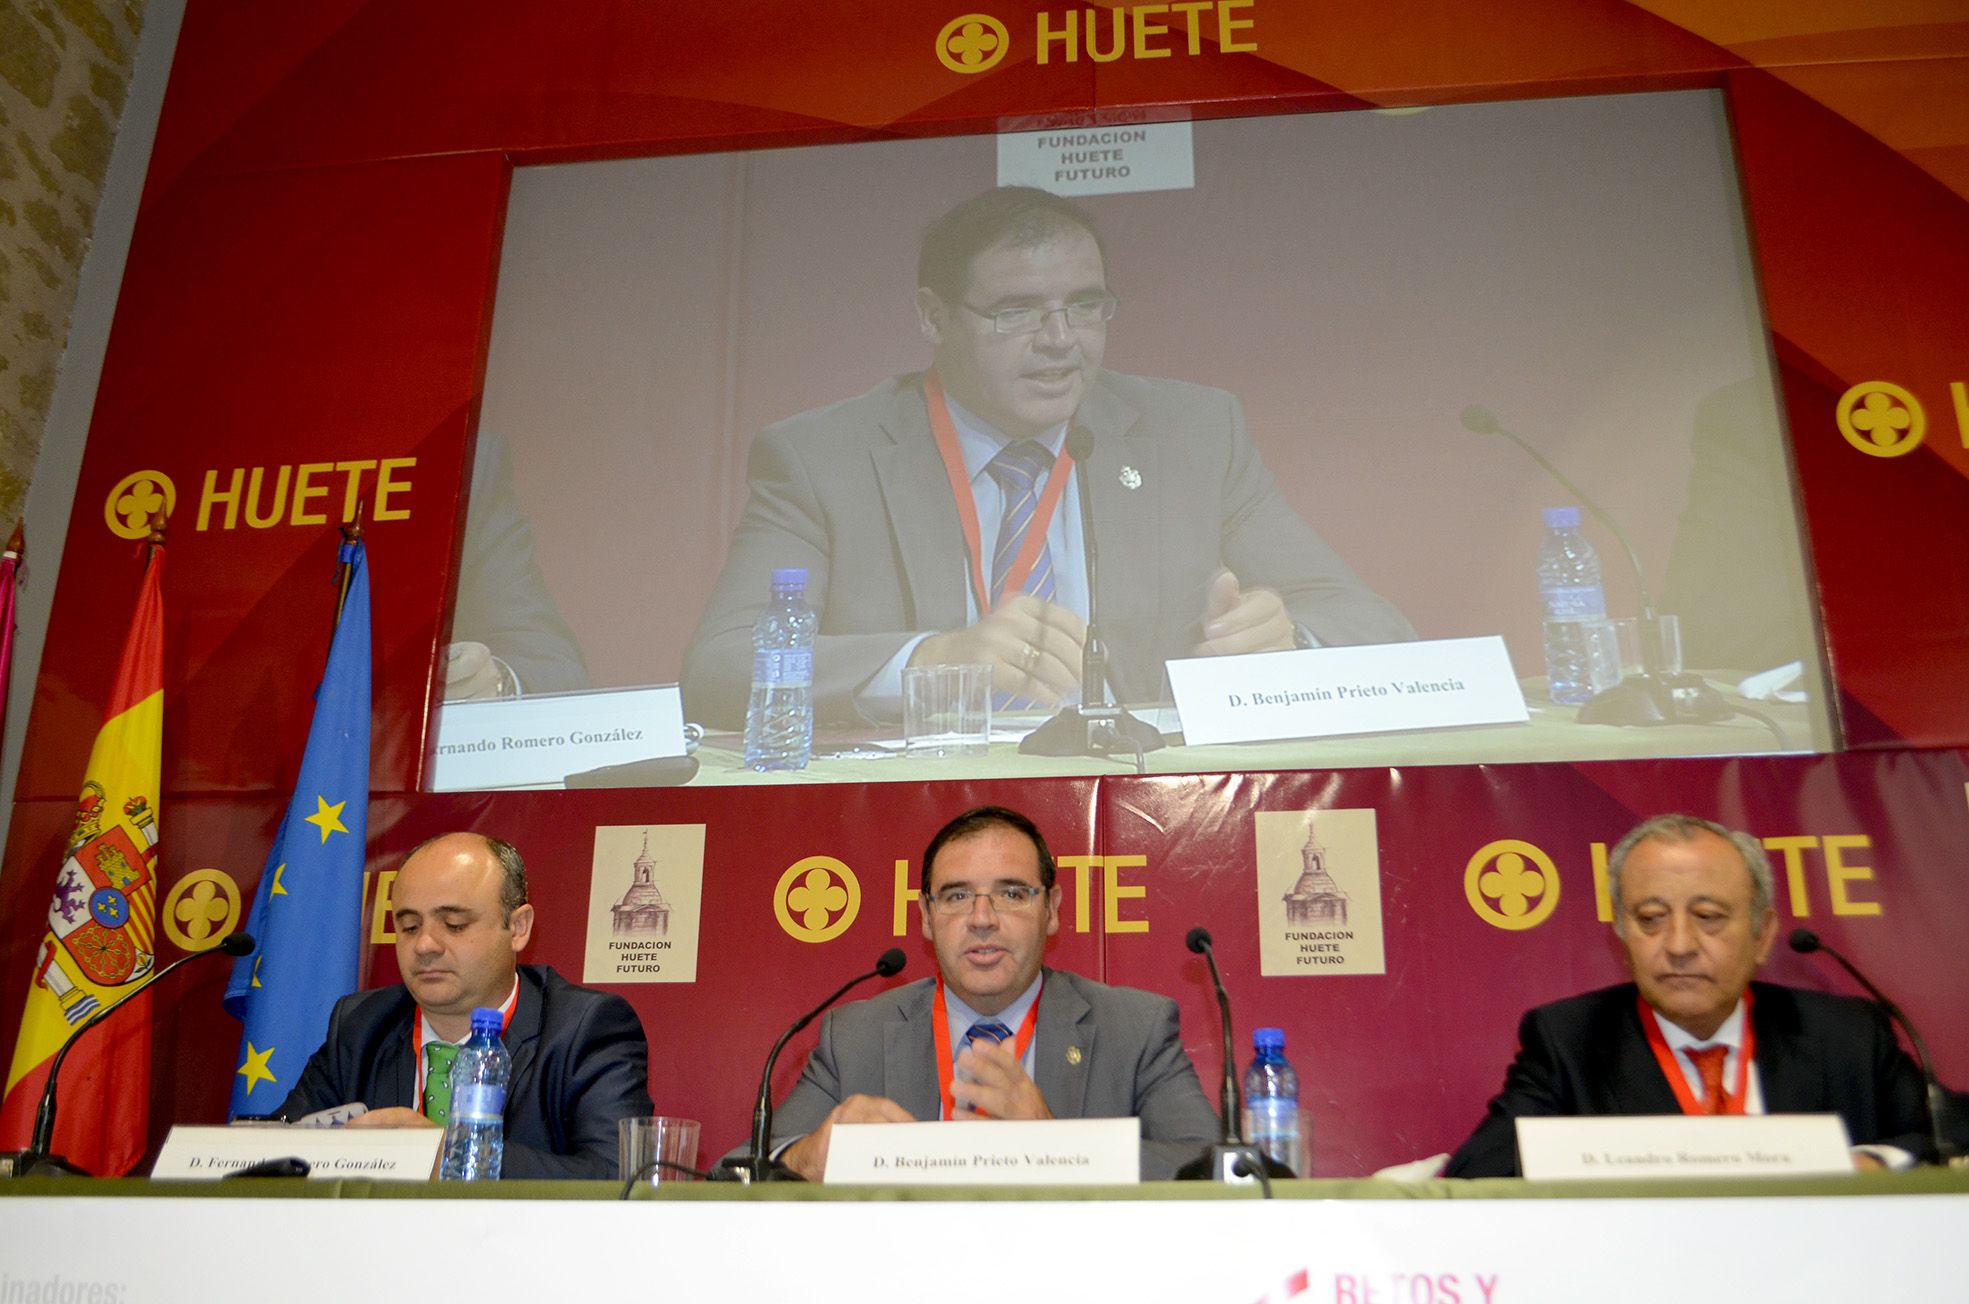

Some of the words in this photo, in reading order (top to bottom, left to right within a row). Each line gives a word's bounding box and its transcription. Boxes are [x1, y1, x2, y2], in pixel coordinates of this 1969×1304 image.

[1036, 1, 1258, 65] HUETE
[1037, 130, 1147, 149] FUNDACION
[1061, 149, 1124, 165] HUETE
[1055, 166, 1131, 182] FUTURO
[196, 457, 417, 532] HUETE
[1228, 694, 1248, 708] D.
[1337, 684, 1388, 699] Prieto
[1393, 678, 1465, 695] Valencia
[502, 736, 566, 750] Romero
[570, 727, 645, 744] González
[1285, 931, 1354, 940] FUNDACION
[609, 941, 672, 950] FUNDACION
[1300, 943, 1340, 952] HUETE
[621, 953, 657, 961] HUETE
[1296, 955, 1345, 965] FUTURO
[616, 964, 661, 973] FUTURO
[189, 1157, 203, 1169] D.
[873, 1156, 889, 1168] D.
[973, 1155, 1018, 1167] Prieto
[1024, 1154, 1090, 1167] Valencia
